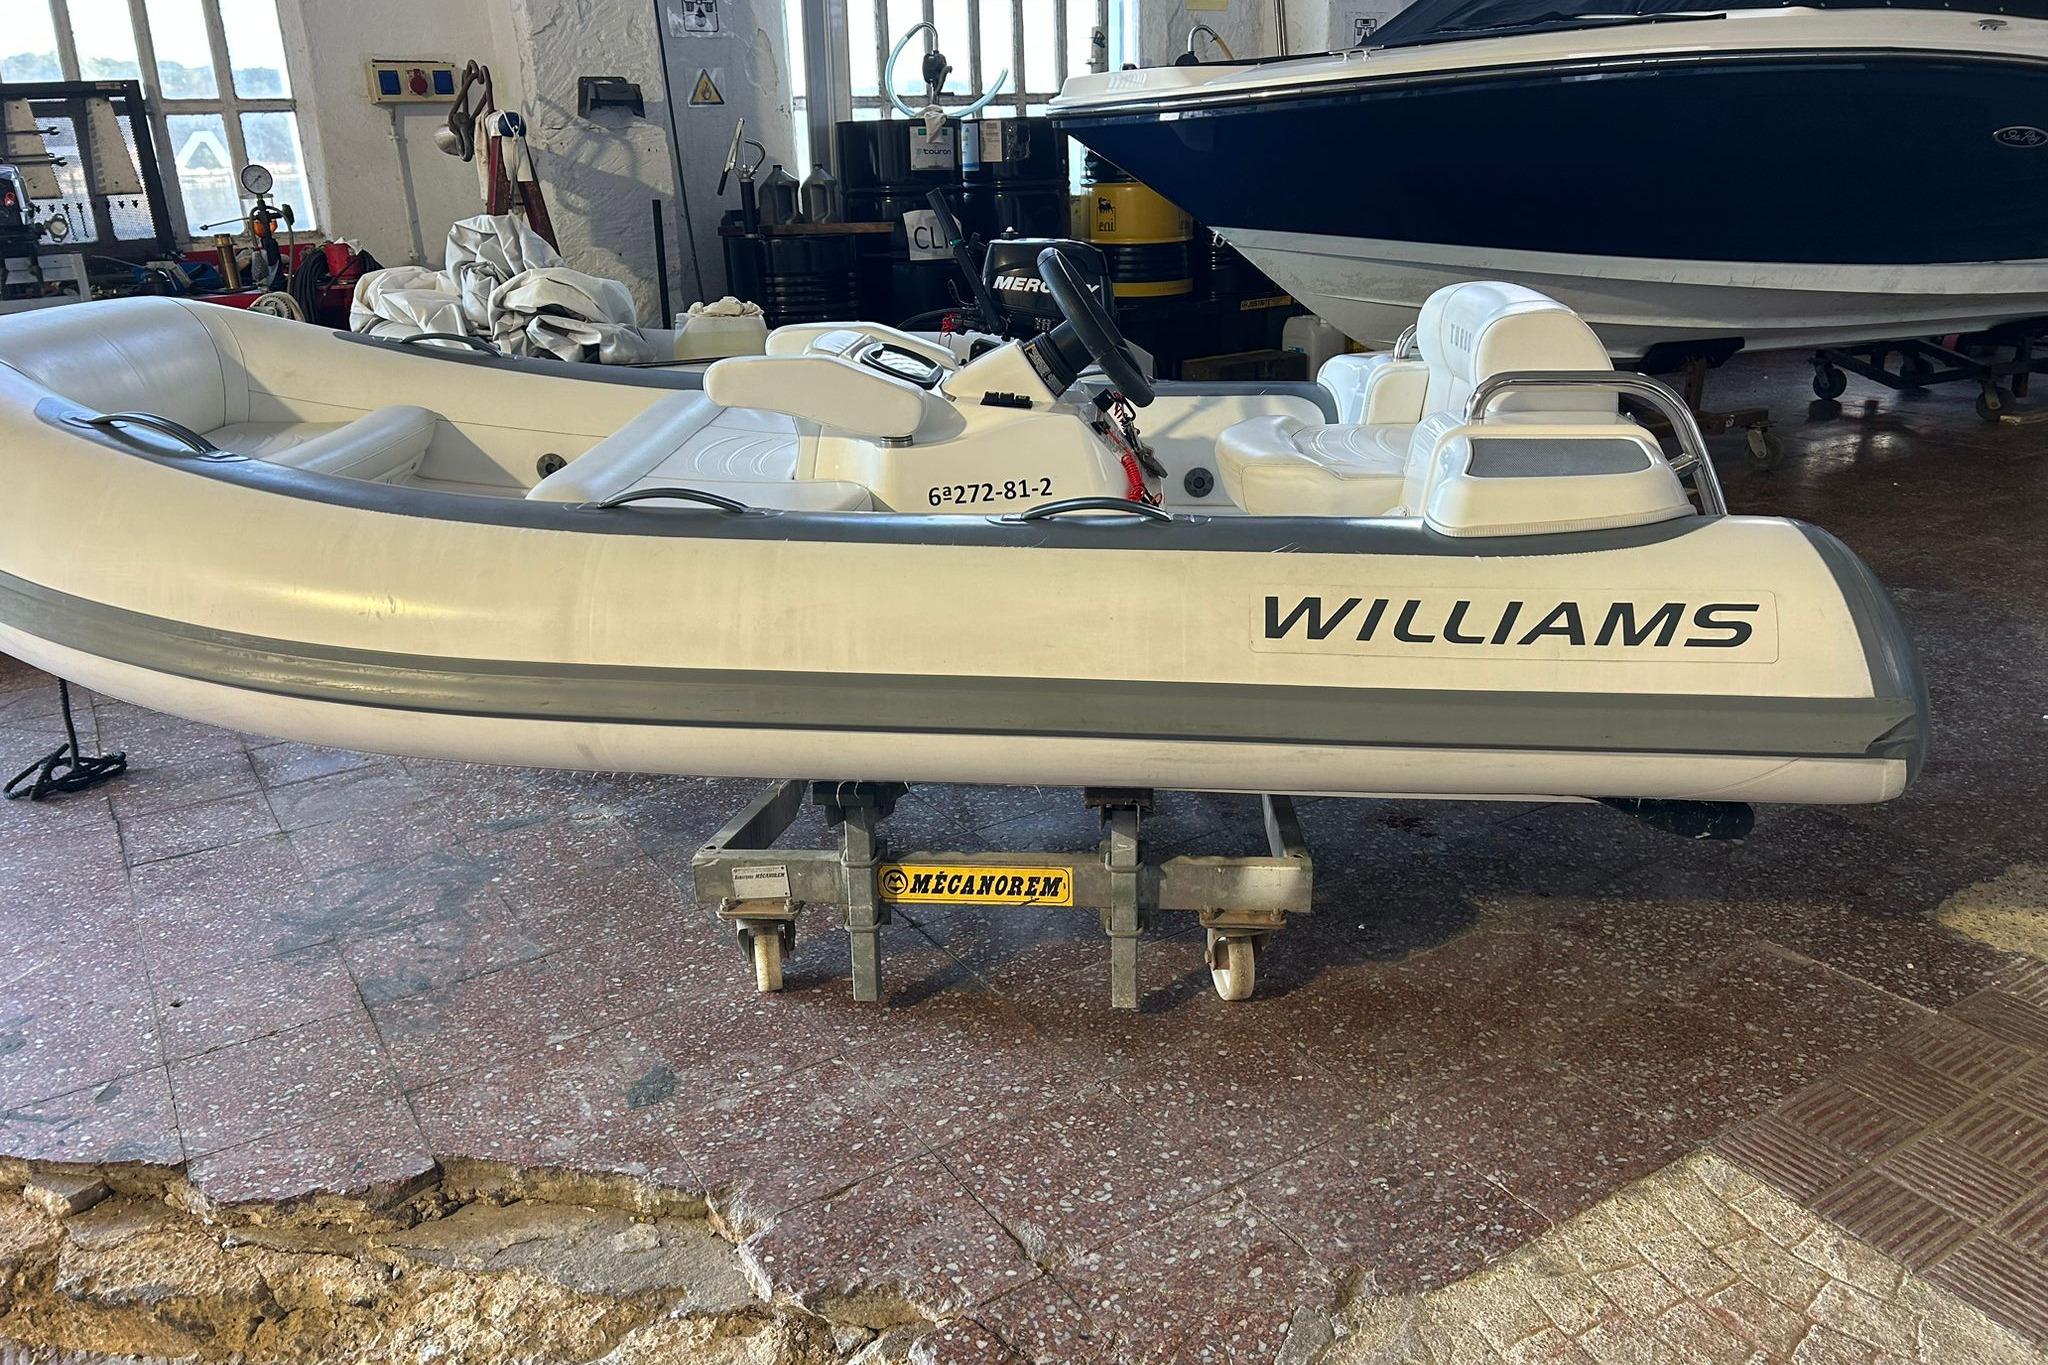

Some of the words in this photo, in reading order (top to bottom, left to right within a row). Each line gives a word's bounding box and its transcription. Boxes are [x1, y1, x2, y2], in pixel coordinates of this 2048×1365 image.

[923, 147, 952, 155] touron
[993, 275, 1099, 294] MERCY
[928, 477, 1053, 506] 6ª272-81-2
[1264, 596, 1760, 648] WILLIAMS
[909, 871, 1063, 897] MÉCANOREM
